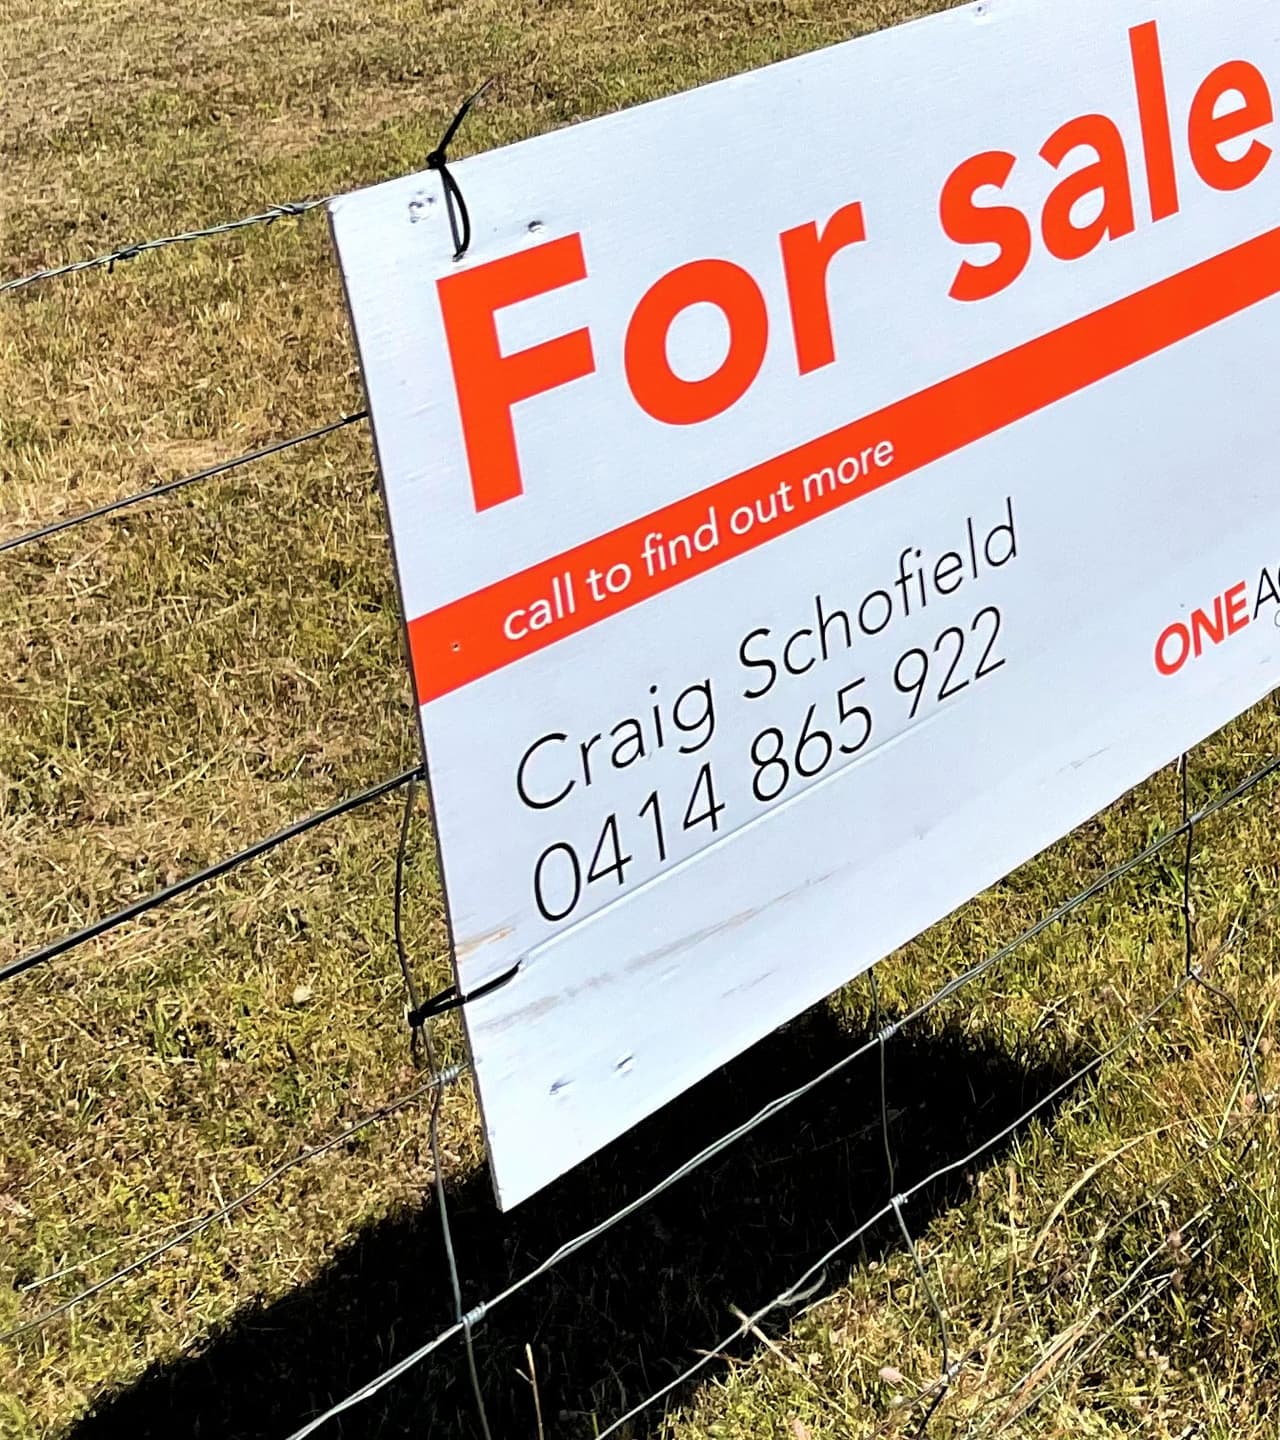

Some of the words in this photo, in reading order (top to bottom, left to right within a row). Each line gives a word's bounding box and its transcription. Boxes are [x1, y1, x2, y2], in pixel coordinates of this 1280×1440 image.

[437, 201, 866, 512] For
[940, 20, 1274, 302] sale
[503, 572, 577, 641] call
[585, 568, 632, 602] to
[641, 506, 719, 577] find
[730, 481, 795, 536] out
[801, 439, 895, 503] more
[516, 677, 717, 810] Craig
[739, 496, 1018, 699] Schofield
[1154, 579, 1251, 677] ONE
[533, 762, 726, 922] 0414
[750, 677, 873, 802] 865
[893, 605, 1006, 720] 922
